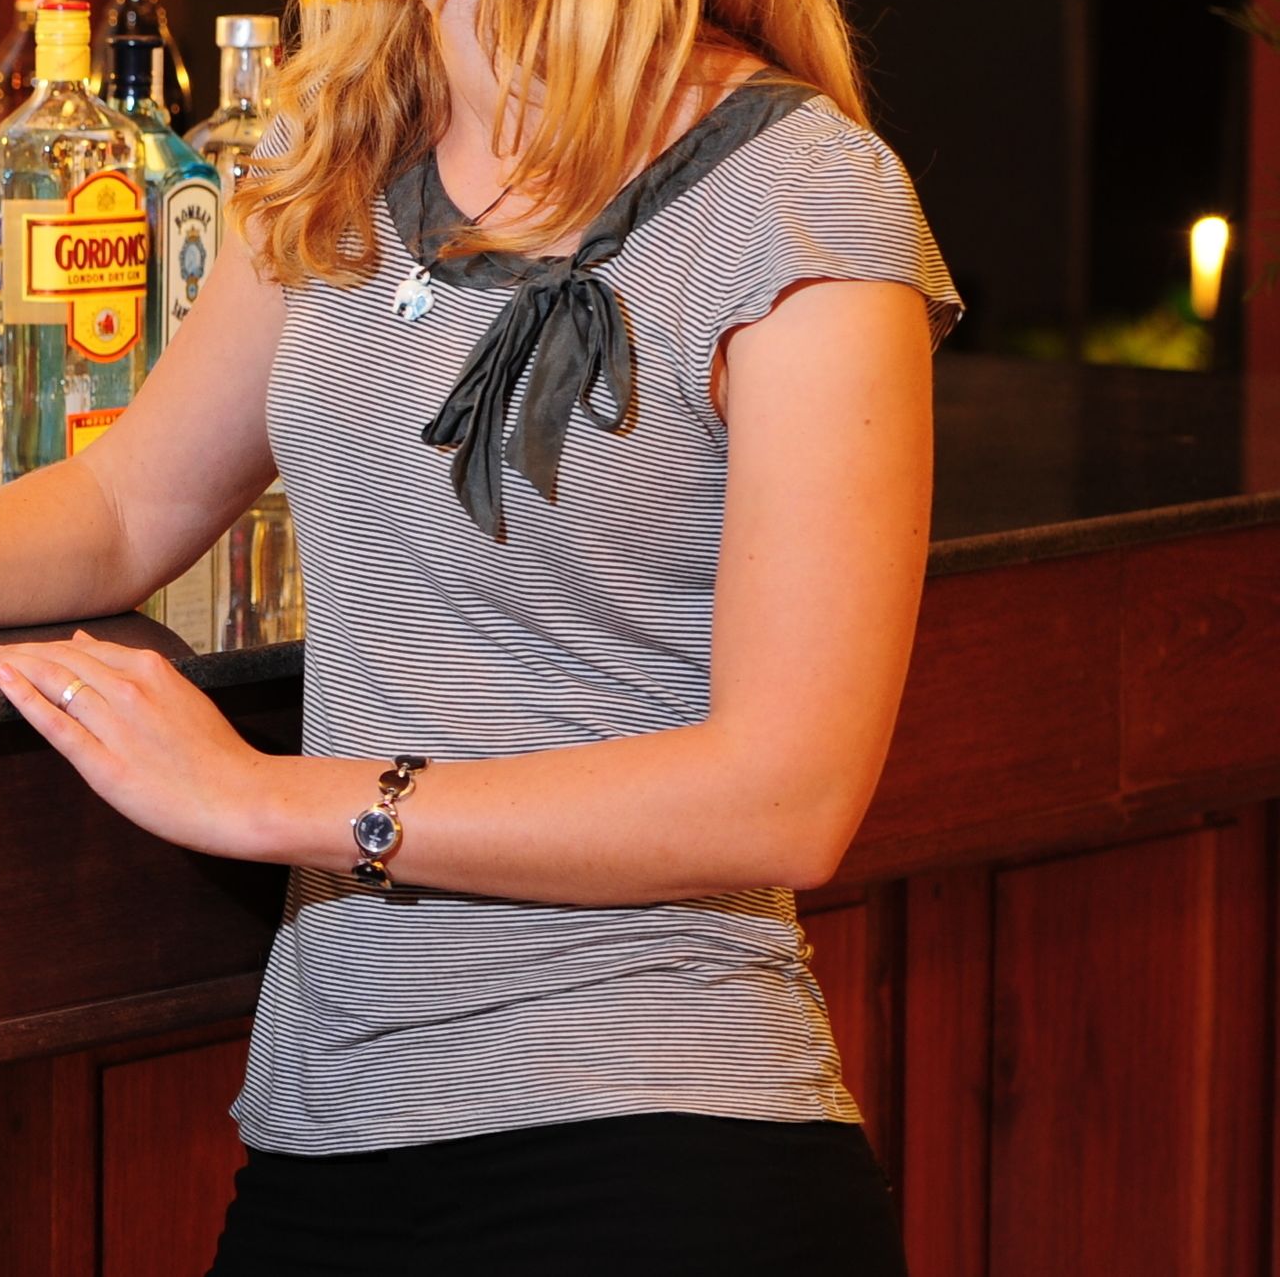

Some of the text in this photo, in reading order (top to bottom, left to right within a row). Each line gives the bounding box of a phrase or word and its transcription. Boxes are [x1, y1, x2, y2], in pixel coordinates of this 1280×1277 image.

[55, 233, 146, 271] GORDON'S
[68, 271, 140, 285] LONDON DRY GIN
